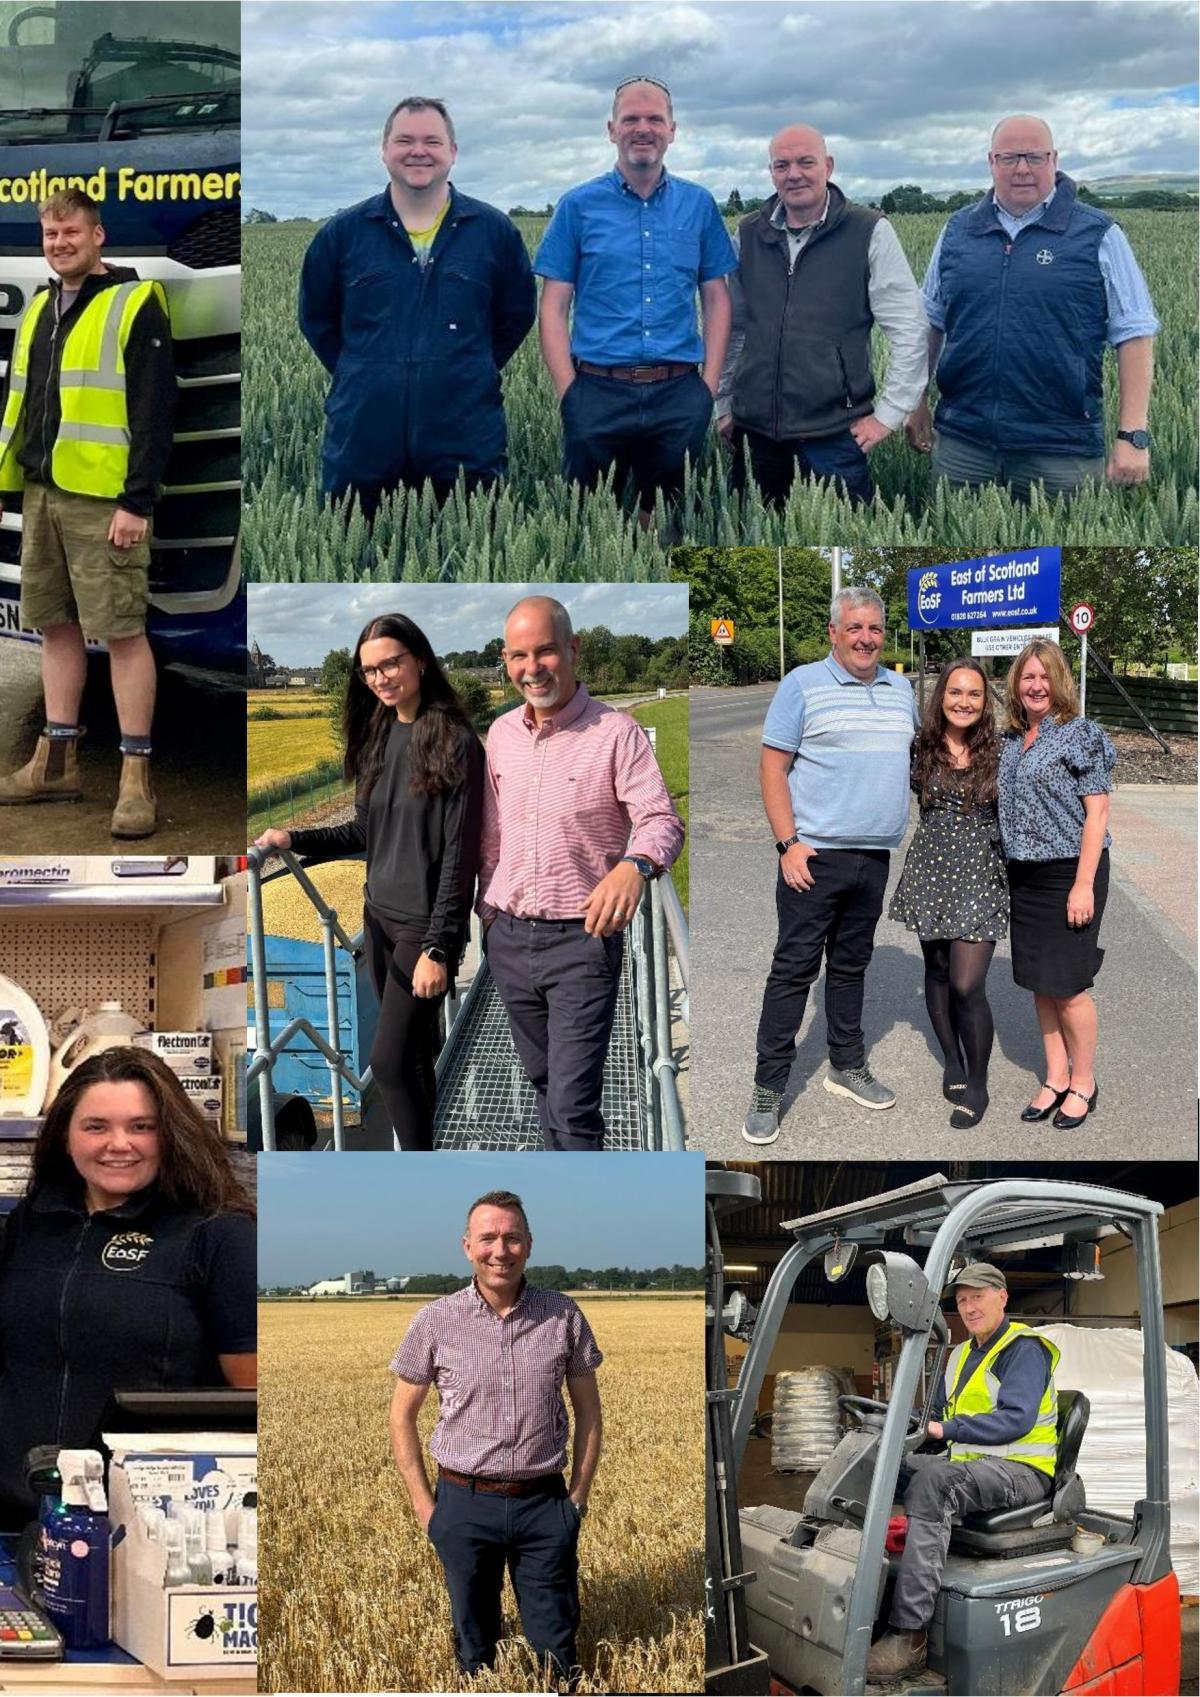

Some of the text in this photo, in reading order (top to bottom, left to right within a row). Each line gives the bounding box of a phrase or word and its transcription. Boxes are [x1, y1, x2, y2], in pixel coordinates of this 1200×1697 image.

[118, 168, 242, 202] Farmer
[951, 556, 1039, 586] East of Scotland
[920, 593, 942, 610] EoSF
[962, 582, 1025, 605] Farmers Ltd
[1075, 613, 1088, 625] 10
[107, 1247, 150, 1262] EoSF
[1000, 1606, 1041, 1636] 18
